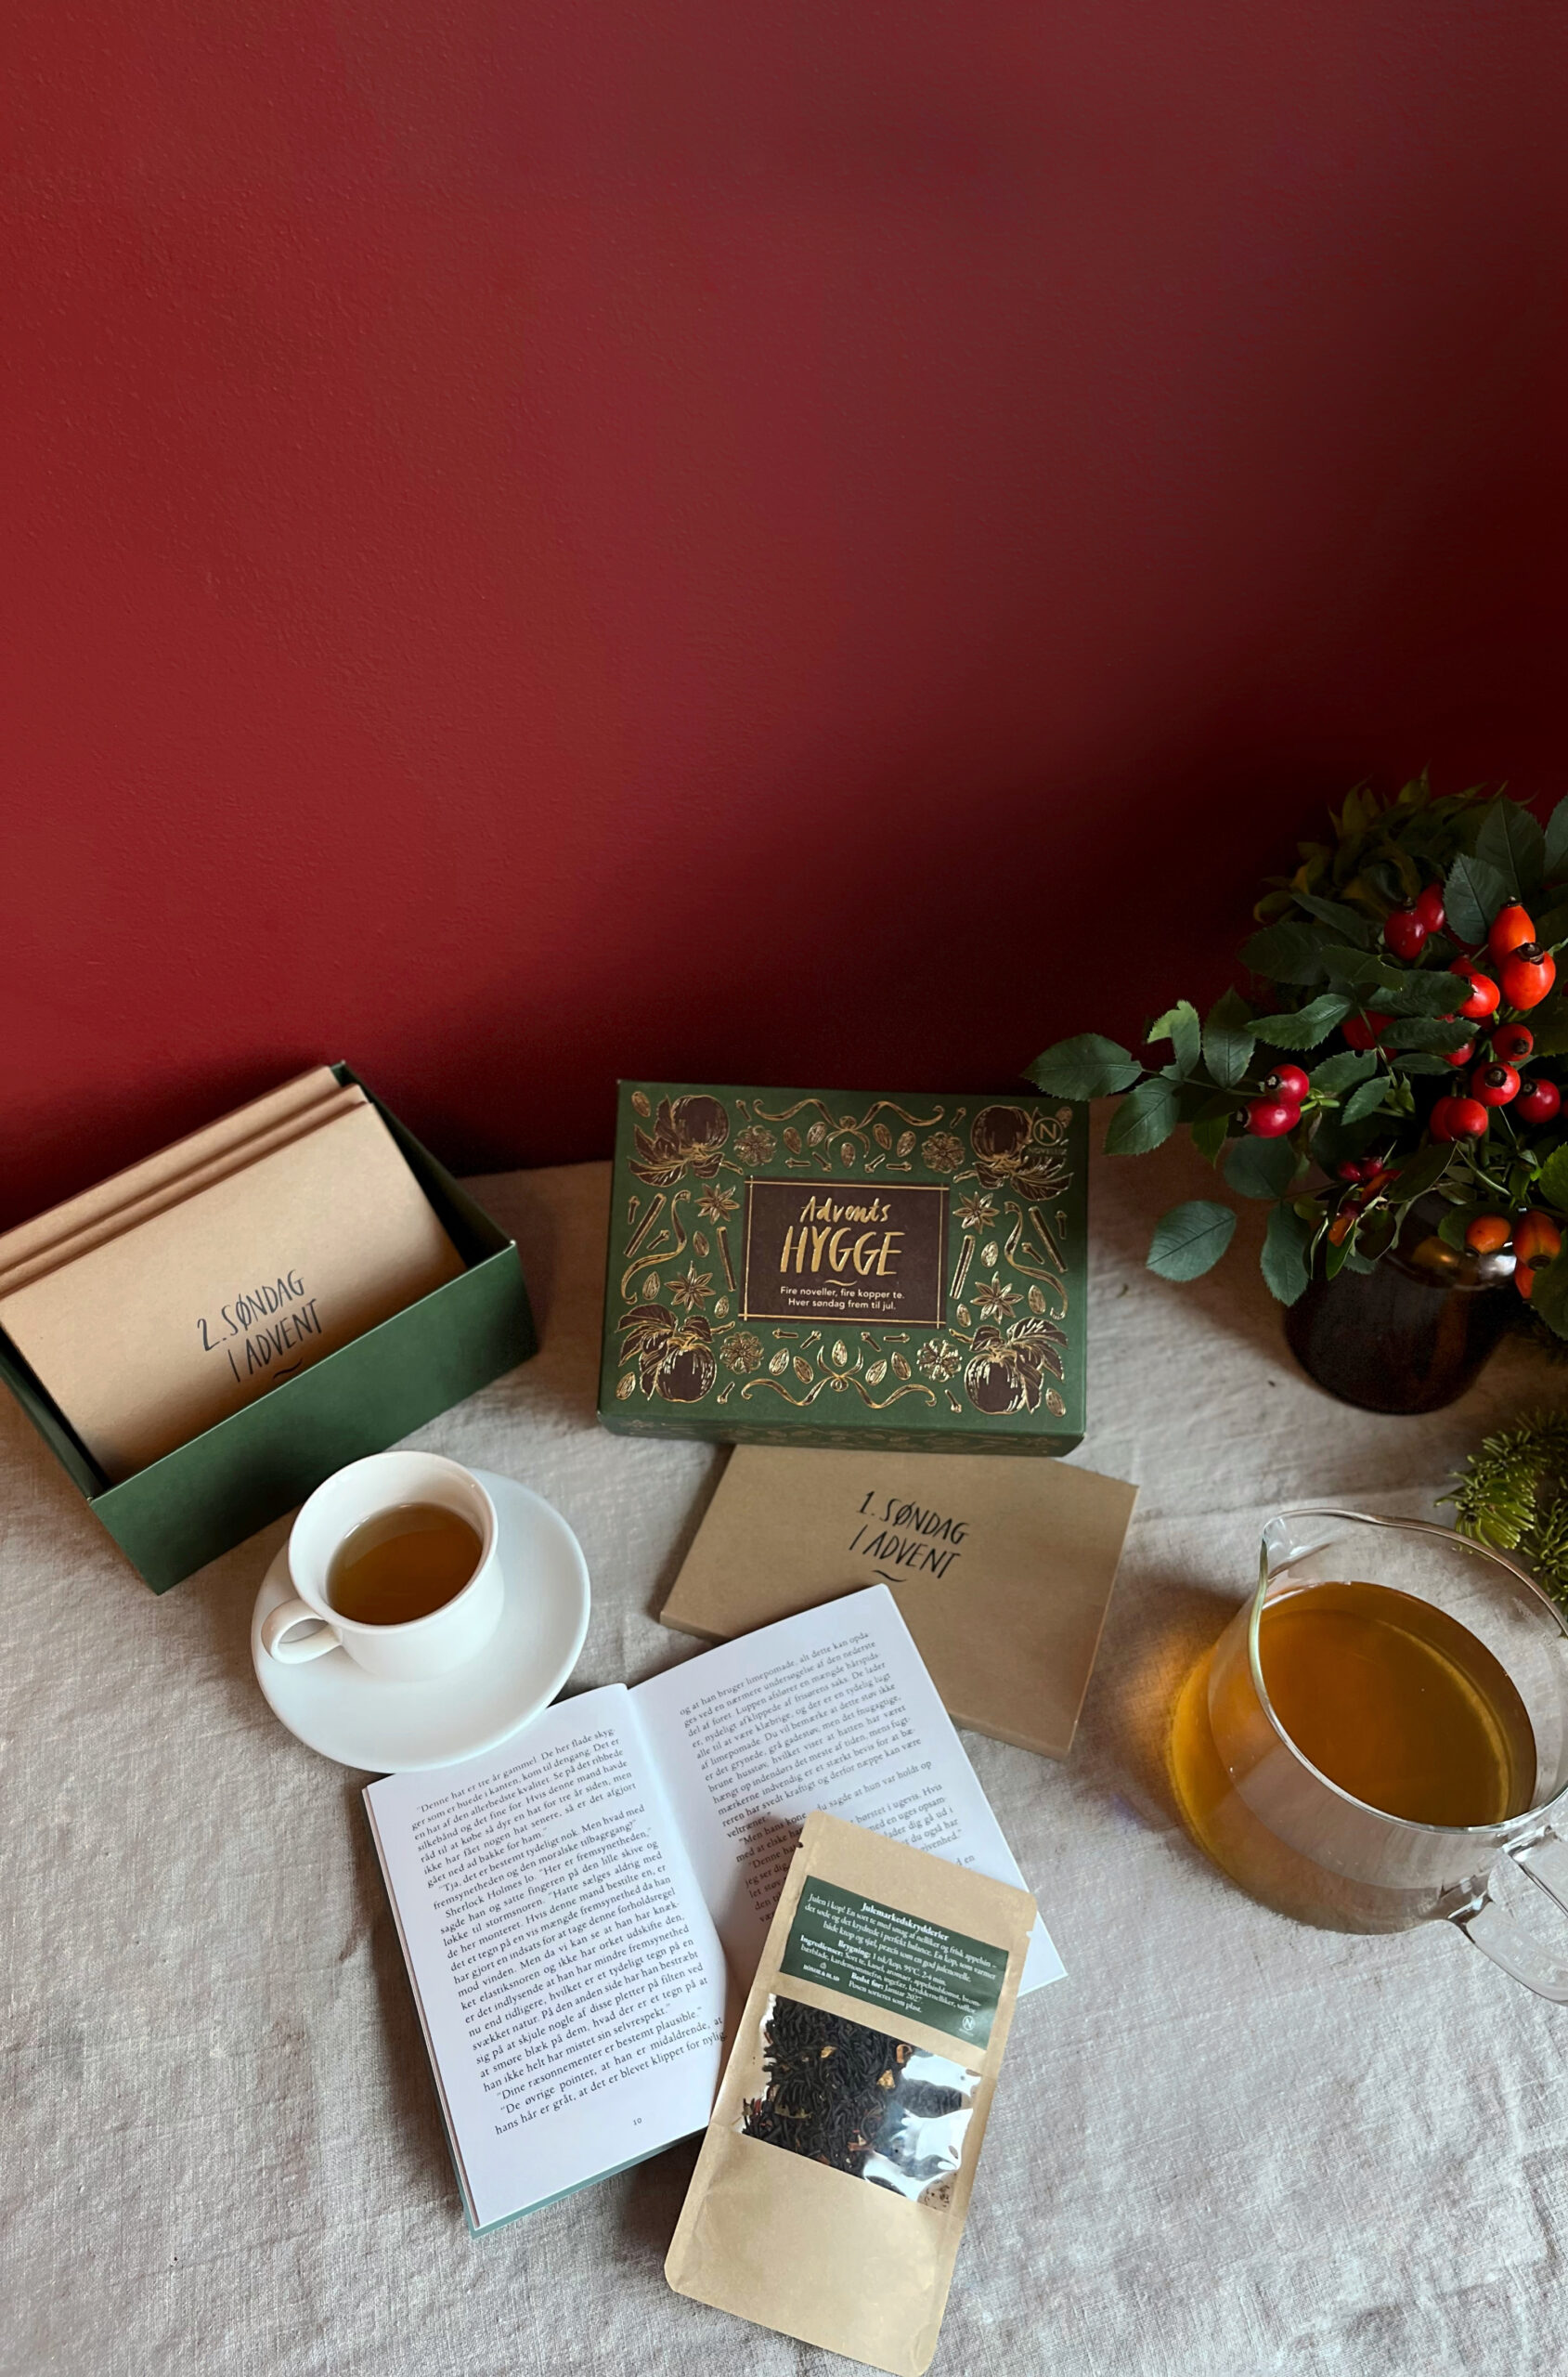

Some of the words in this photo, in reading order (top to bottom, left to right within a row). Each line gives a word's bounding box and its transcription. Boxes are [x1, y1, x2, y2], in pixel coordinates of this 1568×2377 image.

[1039, 1123, 1057, 1141] N
[800, 1196, 891, 1223] Advents
[780, 1226, 906, 1276] HYGGE
[197, 1318, 227, 1352] 2.
[221, 1268, 305, 1336] SØNDAG
[780, 1286, 798, 1295] Fire
[800, 1287, 838, 1298] noveller,
[840, 1288, 856, 1297] fire
[858, 1289, 890, 1301] kopper
[892, 1291, 905, 1300] te.
[788, 1298, 810, 1306] Hver
[812, 1298, 846, 1310] søndag
[848, 1299, 869, 1308] frem
[871, 1300, 881, 1309] til
[881, 1300, 897, 1312] jul.
[227, 1348, 241, 1383] I
[246, 1298, 322, 1375] ADVENT
[856, 1490, 875, 1516] 1.
[879, 1498, 970, 1545] SØNDAG
[849, 1524, 868, 1551] I
[862, 1530, 962, 1579] ADVENT
[445, 1894, 486, 1918] Sherlock
[486, 1879, 523, 1900] Holmes
[449, 1959, 466, 1972] det
[477, 1945, 499, 1959] tegn
[525, 1928, 539, 1938] vis
[539, 1910, 578, 1932] mængde
[578, 1884, 641, 1916] fremsynethed
[653, 1877, 671, 1888] han
[807, 1892, 826, 1905] Julen
[875, 1920, 891, 1929] med
[940, 1944, 949, 1954] og
[831, 1915, 840, 1924] og
[860, 1902, 949, 1941] Julemarkedskrydderier
[457, 1980, 480, 1998] mod
[519, 1955, 542, 1970] Men
[568, 1935, 589, 1948] kan
[614, 1917, 633, 1929] han
[633, 1910, 651, 1922] har
[476, 2006, 493, 2019] det
[493, 1982, 544, 2011] indlysende
[555, 1969, 576, 1983] han
[575, 1962, 592, 1975] har
[593, 1948, 628, 1968] mindre
[628, 1923, 690, 1954] fremsynethed
[484, 2014, 502, 2030] end
[548, 1981, 582, 2001] hvilket
[608, 1955, 644, 1977] tydeligt
[645, 1948, 667, 1961] tegn
[527, 2048, 603, 2088] ræsonnementer
[614, 2027, 654, 2048] bestemt
[494, 2118, 519, 2136] hans
[519, 2110, 538, 2124] hår
[590, 2079, 606, 2092] det
[618, 2060, 650, 2079] blevet
[649, 2046, 684, 2066] klippet
[685, 2040, 700, 2051] for
[632, 2117, 642, 2126] 10
